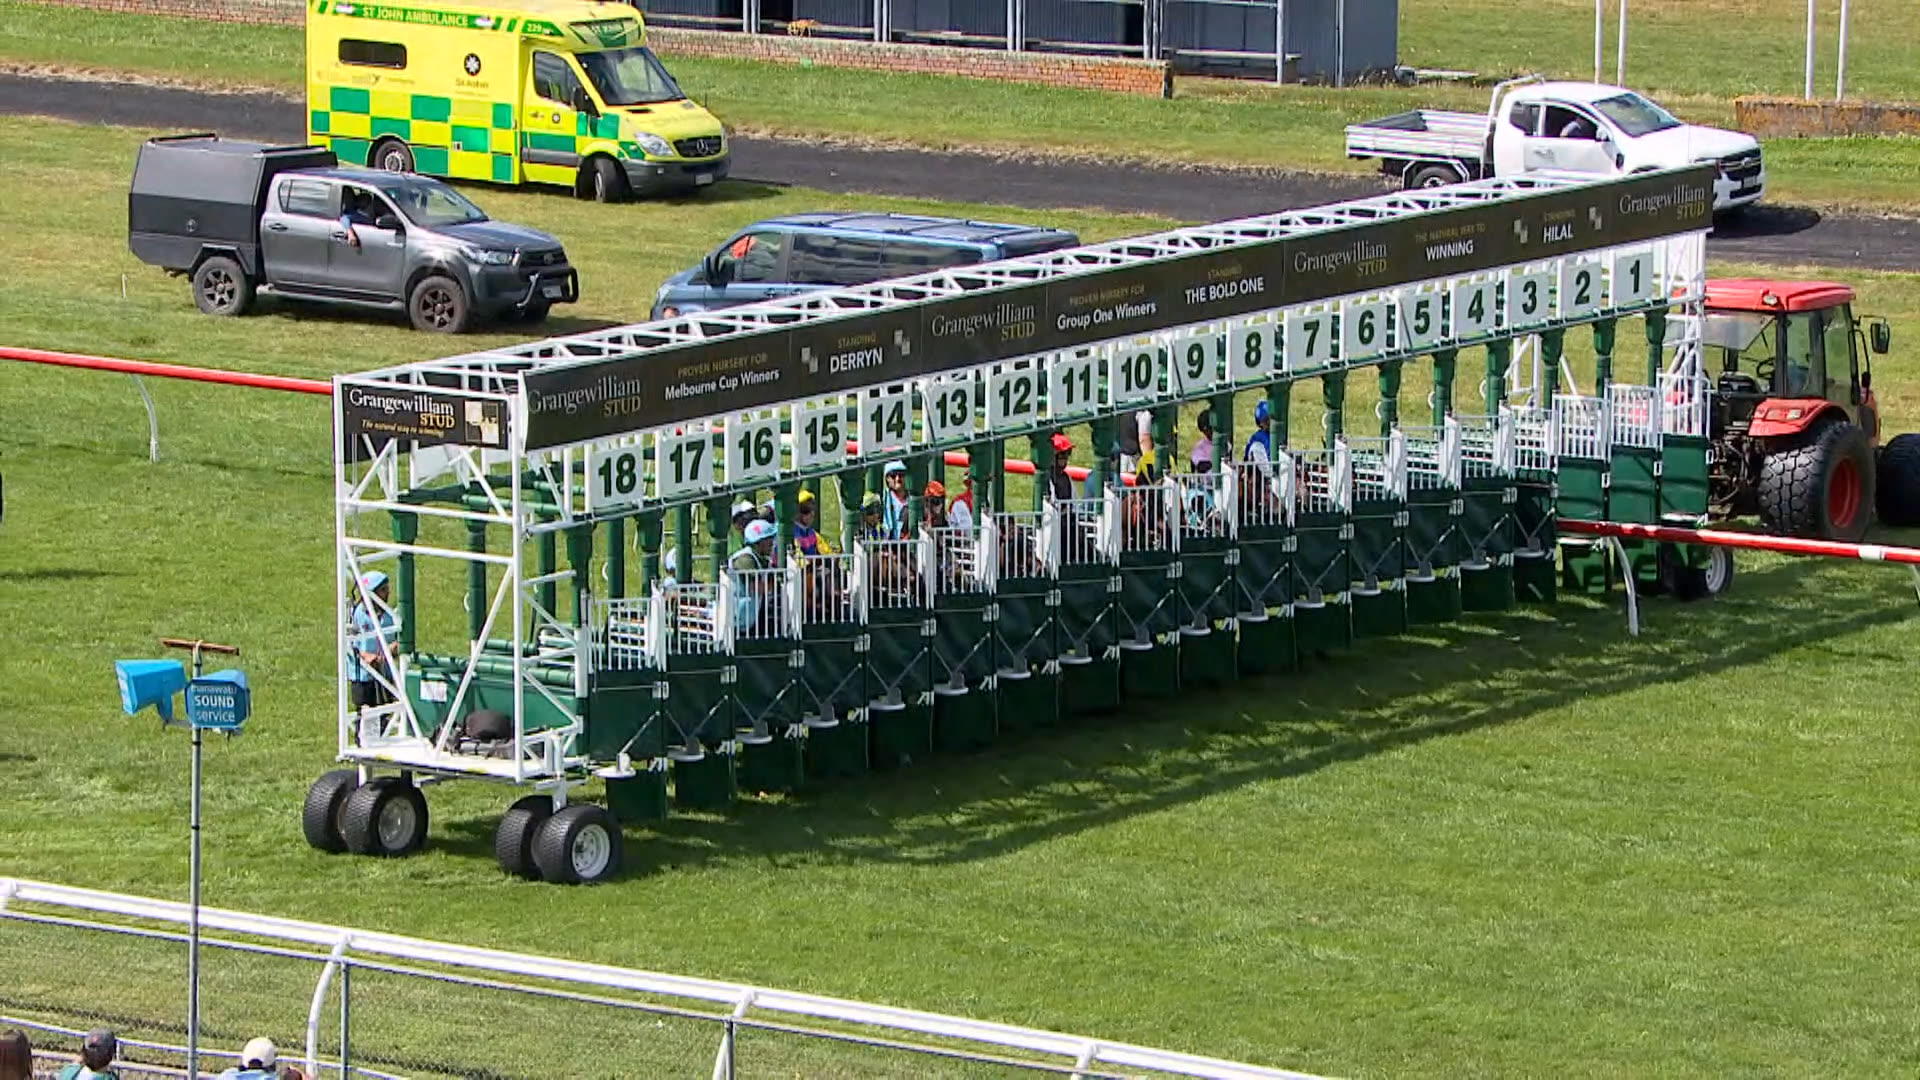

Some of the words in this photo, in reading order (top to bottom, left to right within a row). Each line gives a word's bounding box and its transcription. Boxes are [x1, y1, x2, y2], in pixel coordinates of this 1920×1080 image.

[362, 7, 376, 19] ST
[377, 9, 404, 22] JOHN
[405, 11, 468, 27] AMBULANCE
[1619, 184, 1705, 216] Grangewilliam
[1676, 202, 1705, 221] STUD
[1543, 222, 1574, 244] HILAL
[1294, 240, 1387, 274] Grangewilliam
[1357, 258, 1387, 277] STUD
[1426, 240, 1474, 261] WINNING
[1129, 283, 1145, 298] FOR
[1185, 288, 1207, 305] THE
[1209, 281, 1238, 302] BOLD
[1239, 276, 1264, 295] ONE
[1575, 270, 1590, 305] 2
[1630, 259, 1640, 294] 1
[1467, 289, 1484, 324] 4
[1522, 280, 1537, 315] 3
[931, 303, 1035, 339] Grangewilliam
[1001, 321, 1035, 342] STUD
[1057, 310, 1091, 331] Group
[1093, 307, 1114, 325] One
[1115, 300, 1157, 320] Winners
[1358, 309, 1375, 345] 6
[1414, 300, 1430, 335] 5
[837, 331, 877, 349] STANDING
[1245, 332, 1262, 368] 8
[1303, 319, 1320, 358] 7
[677, 360, 710, 379] PROVEN
[712, 356, 748, 374] NURSERY
[750, 351, 768, 367] FOR
[830, 347, 883, 375] DERRYN
[1121, 353, 1151, 392] 10
[1187, 343, 1204, 379] 9
[528, 375, 641, 414] Grangewilliam
[665, 379, 717, 401] Melbourne
[718, 375, 738, 393] Cup
[740, 368, 780, 387] Winners
[999, 376, 1031, 417] 12
[1062, 363, 1091, 404] 11
[350, 388, 454, 415] Grangewilliam
[603, 396, 641, 417] STUD
[936, 388, 968, 429] 13
[420, 413, 455, 428] STUD
[805, 412, 840, 455] 15
[870, 400, 906, 443] 14
[669, 439, 706, 484] 17
[738, 427, 774, 470] 16
[598, 452, 637, 497] 18
[194, 695, 235, 708] SOUND
[196, 710, 236, 722] service
